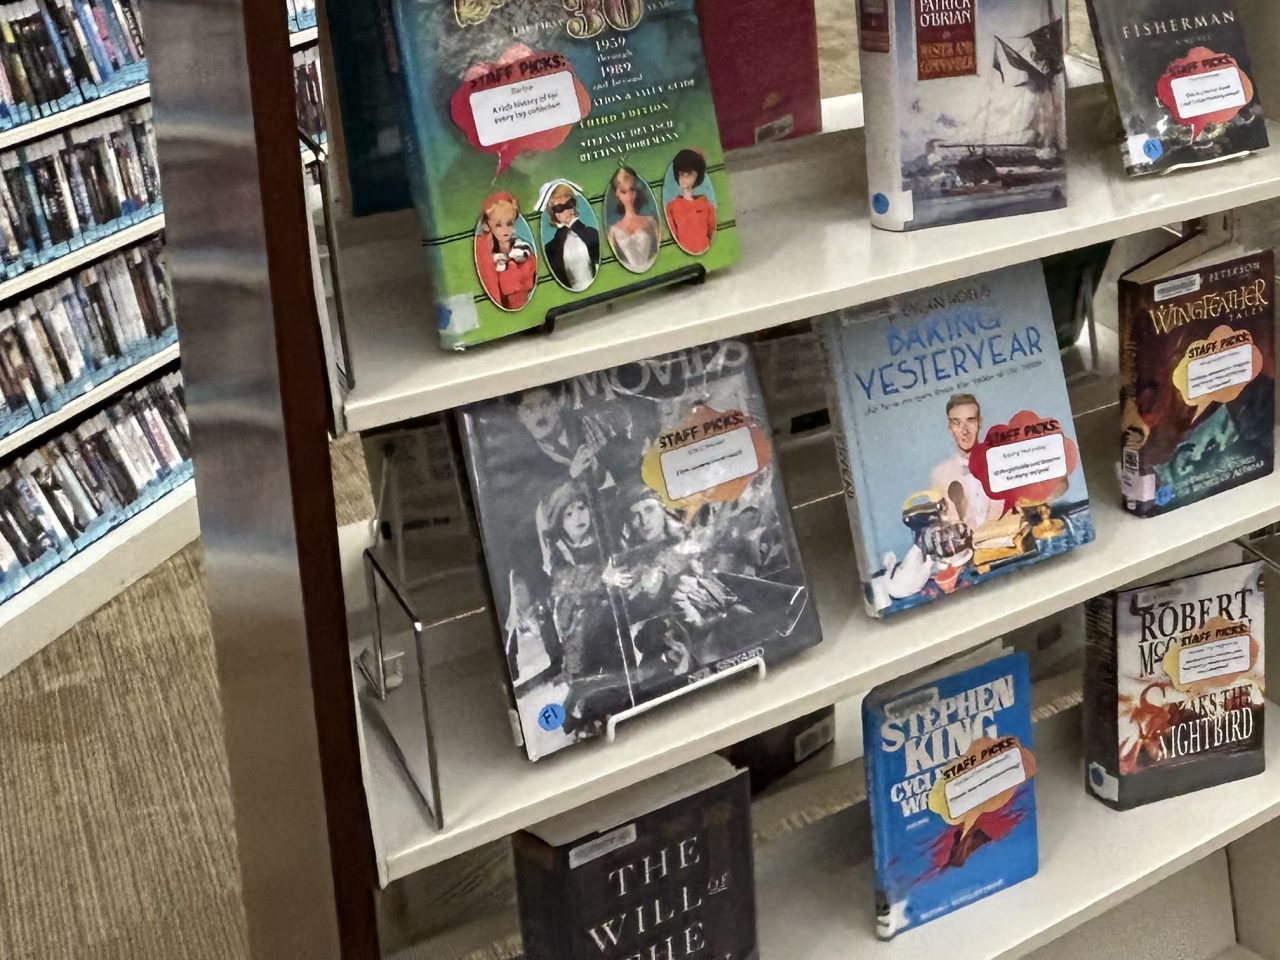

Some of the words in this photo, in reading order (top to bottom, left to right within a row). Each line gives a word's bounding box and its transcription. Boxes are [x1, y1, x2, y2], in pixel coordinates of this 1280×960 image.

[920, 10, 971, 28] O'BRIAN
[1122, 9, 1235, 39] FISHERMAN
[470, 65, 513, 89] STAFF
[1148, 278, 1269, 336] WINGFEATHER
[885, 304, 1003, 357] BAKING
[1188, 340, 1218, 359] STAFF
[853, 325, 1044, 401] YESTERYEAR
[658, 425, 698, 449] STAFF
[1140, 589, 1253, 644] ROBERT
[1180, 630, 1211, 647] STAFF
[542, 708, 558, 726] F1
[880, 674, 1015, 753] STEPHEN
[1155, 707, 1254, 762] NIGHTBIRD
[904, 709, 999, 778] KING
[943, 754, 977, 780] STAFF
[608, 835, 701, 897] THE
[588, 886, 703, 953] WILL
[625, 922, 706, 960] HE
